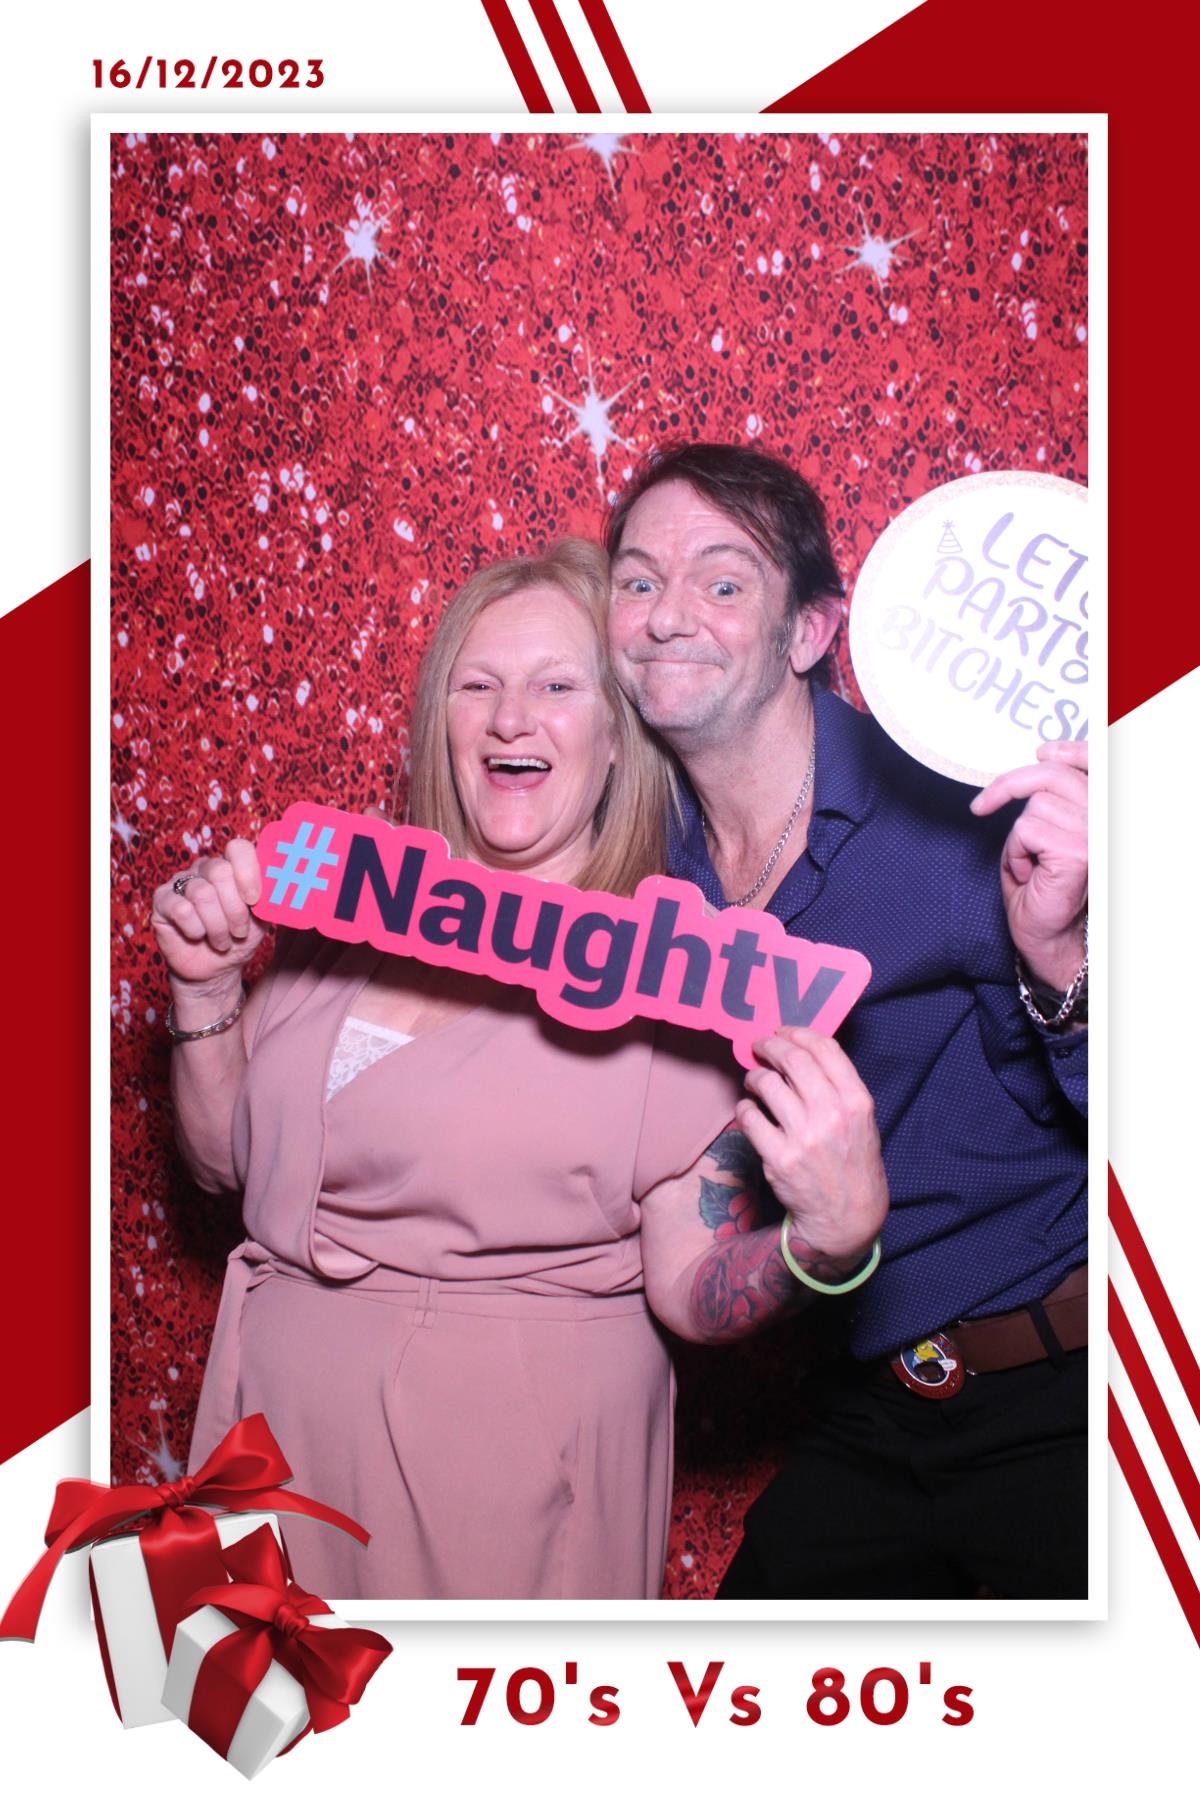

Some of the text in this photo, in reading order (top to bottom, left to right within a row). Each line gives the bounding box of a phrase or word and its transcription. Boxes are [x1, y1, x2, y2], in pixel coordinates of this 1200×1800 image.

[982, 511, 1088, 620] LET
[877, 604, 1088, 742] BITCHES
[266, 821, 846, 1028] #Naughty
